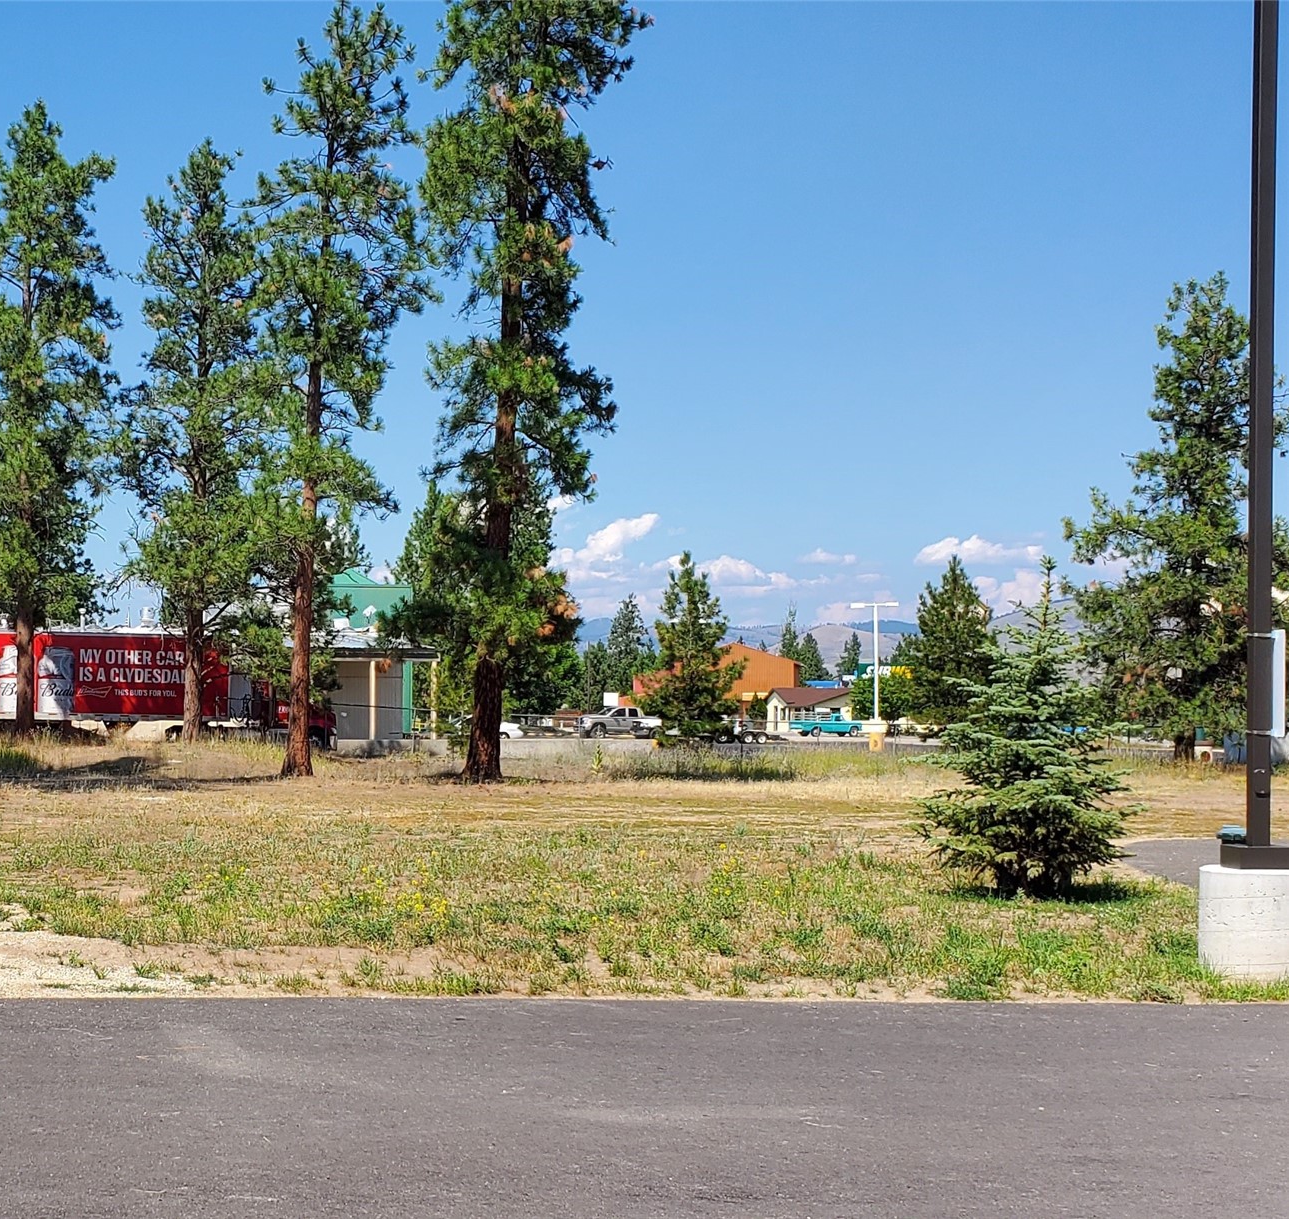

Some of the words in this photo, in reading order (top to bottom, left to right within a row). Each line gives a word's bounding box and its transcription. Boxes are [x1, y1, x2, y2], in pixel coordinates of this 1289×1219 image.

[79, 648, 102, 664] MY
[105, 649, 152, 665] OTHER
[156, 650, 185, 666] CAR
[79, 666, 93, 682] IS
[96, 667, 106, 682] A
[110, 667, 186, 684] CLYDESDAL
[114, 688, 129, 696] THIS
[129, 689, 148, 697] BUD'S
[149, 689, 161, 697] FOR
